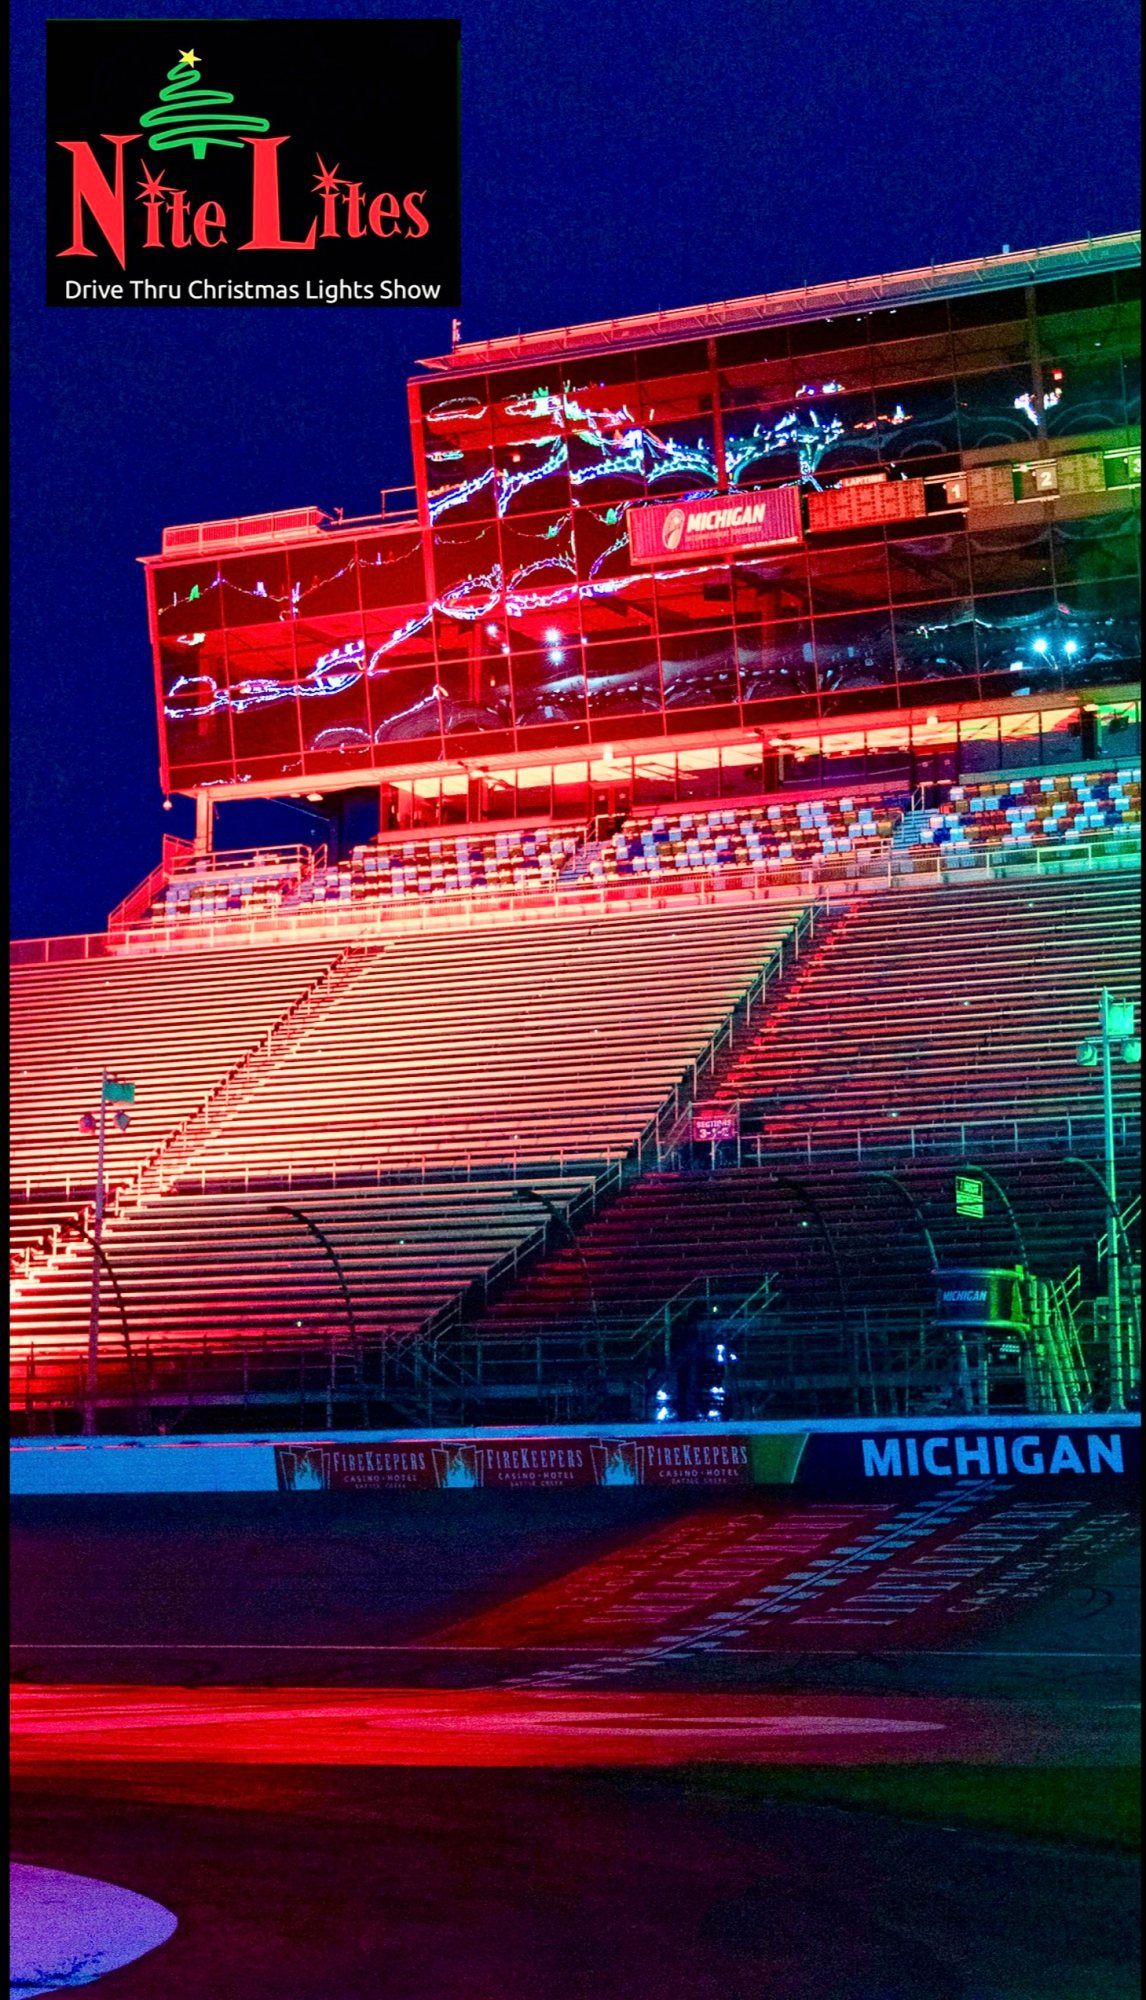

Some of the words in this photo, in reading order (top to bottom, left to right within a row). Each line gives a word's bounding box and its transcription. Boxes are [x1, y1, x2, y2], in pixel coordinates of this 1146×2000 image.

[1040, 471, 1052, 487] 2
[951, 484, 961, 499] 1
[686, 503, 767, 532] MICHIGAN
[942, 1289, 988, 1302] MICHIGAN
[861, 1434, 1124, 1477] MICHIGAN
[343, 1475, 380, 1483] CASINO
[498, 1472, 535, 1480] CASINO
[543, 1471, 574, 1479] HOTEL
[658, 1469, 698, 1477] CASINO
[706, 1468, 739, 1477] HOTEL
